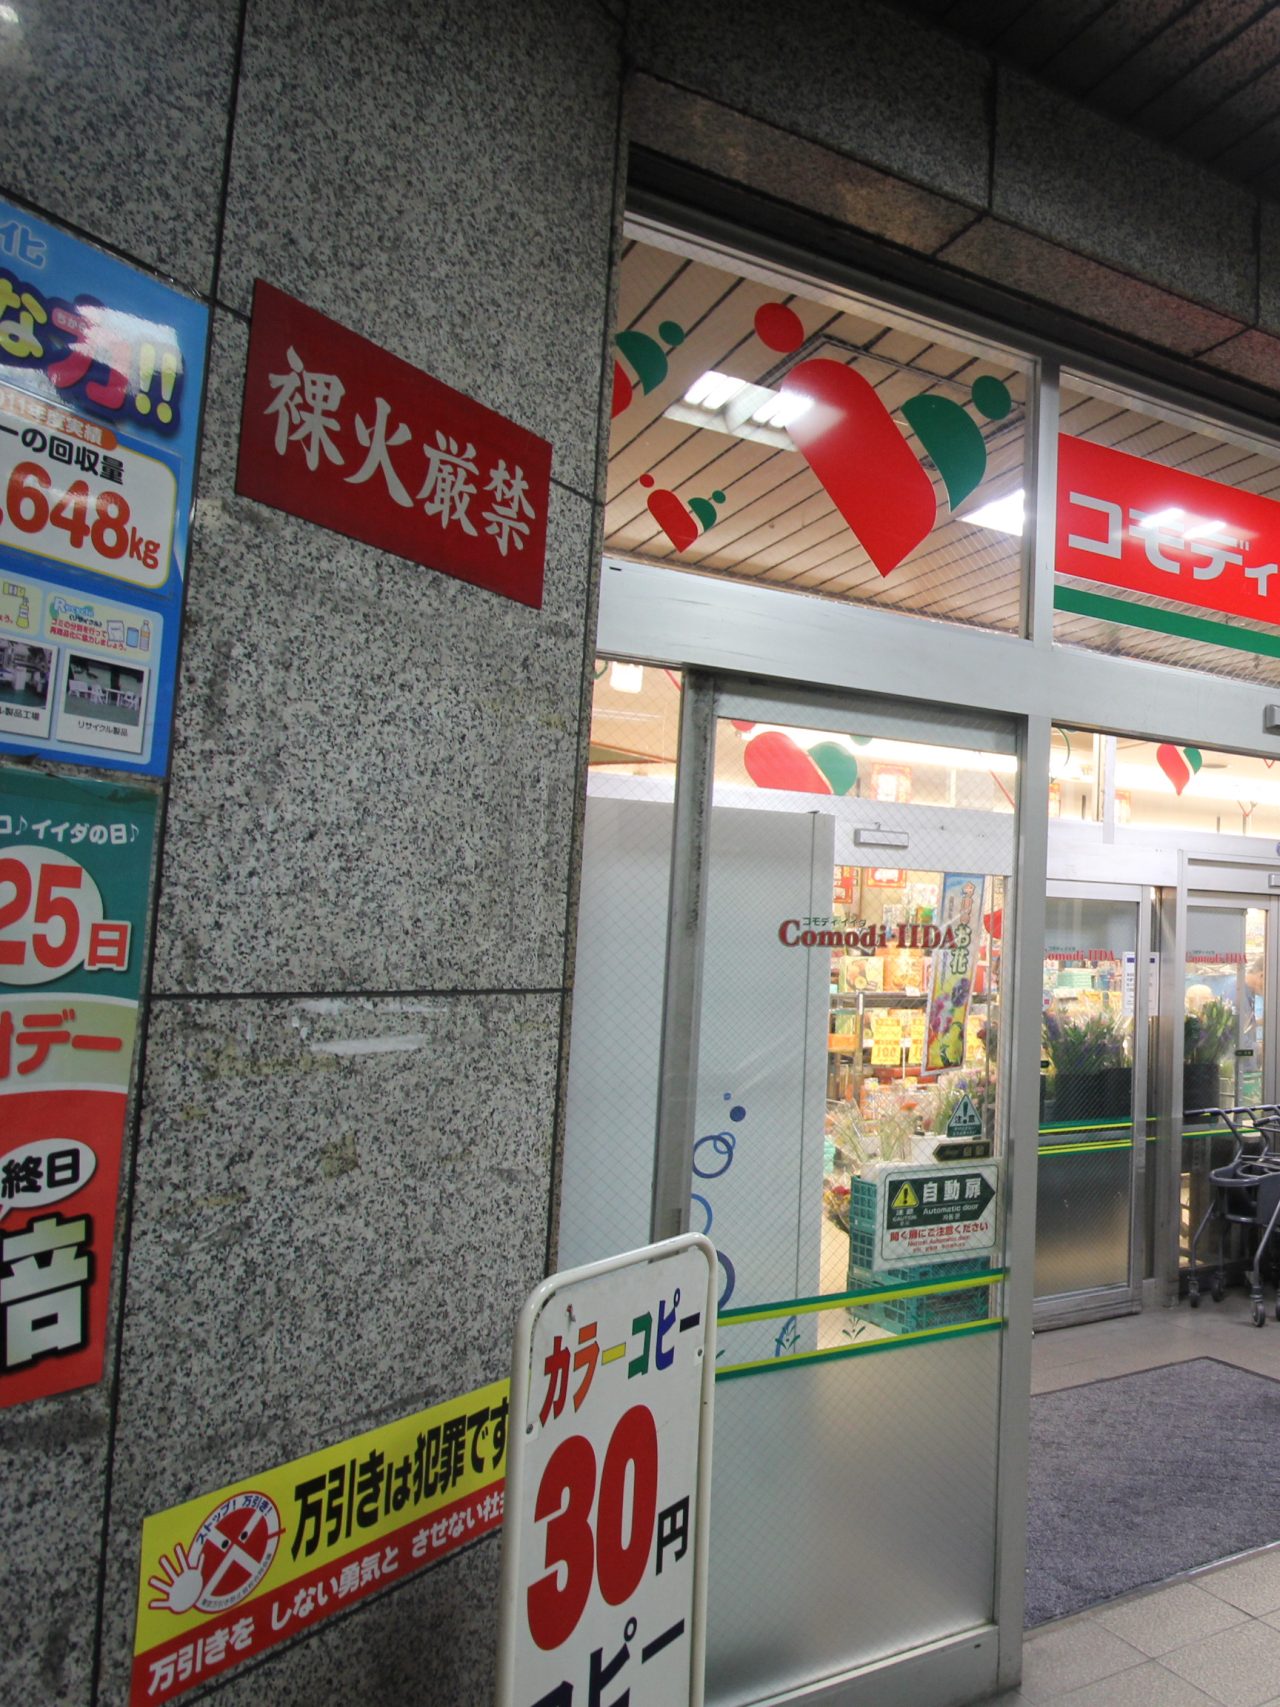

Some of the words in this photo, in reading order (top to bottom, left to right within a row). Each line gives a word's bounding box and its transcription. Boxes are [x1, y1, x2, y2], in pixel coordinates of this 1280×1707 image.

[264, 345, 536, 557] 裸火厳禁
[0, 461, 161, 570] 648kg
[78, 720, 128, 737] リサイクル製品
[0, 1147, 80, 1199] 終日
[922, 1177, 982, 1204] 自動扉
[922, 1205, 962, 1216] Automatic
[962, 1203, 979, 1212] door
[539, 1287, 700, 1427] カラーコピー
[148, 1616, 255, 1697] 万引きを
[271, 1547, 401, 1632] しない勇気と
